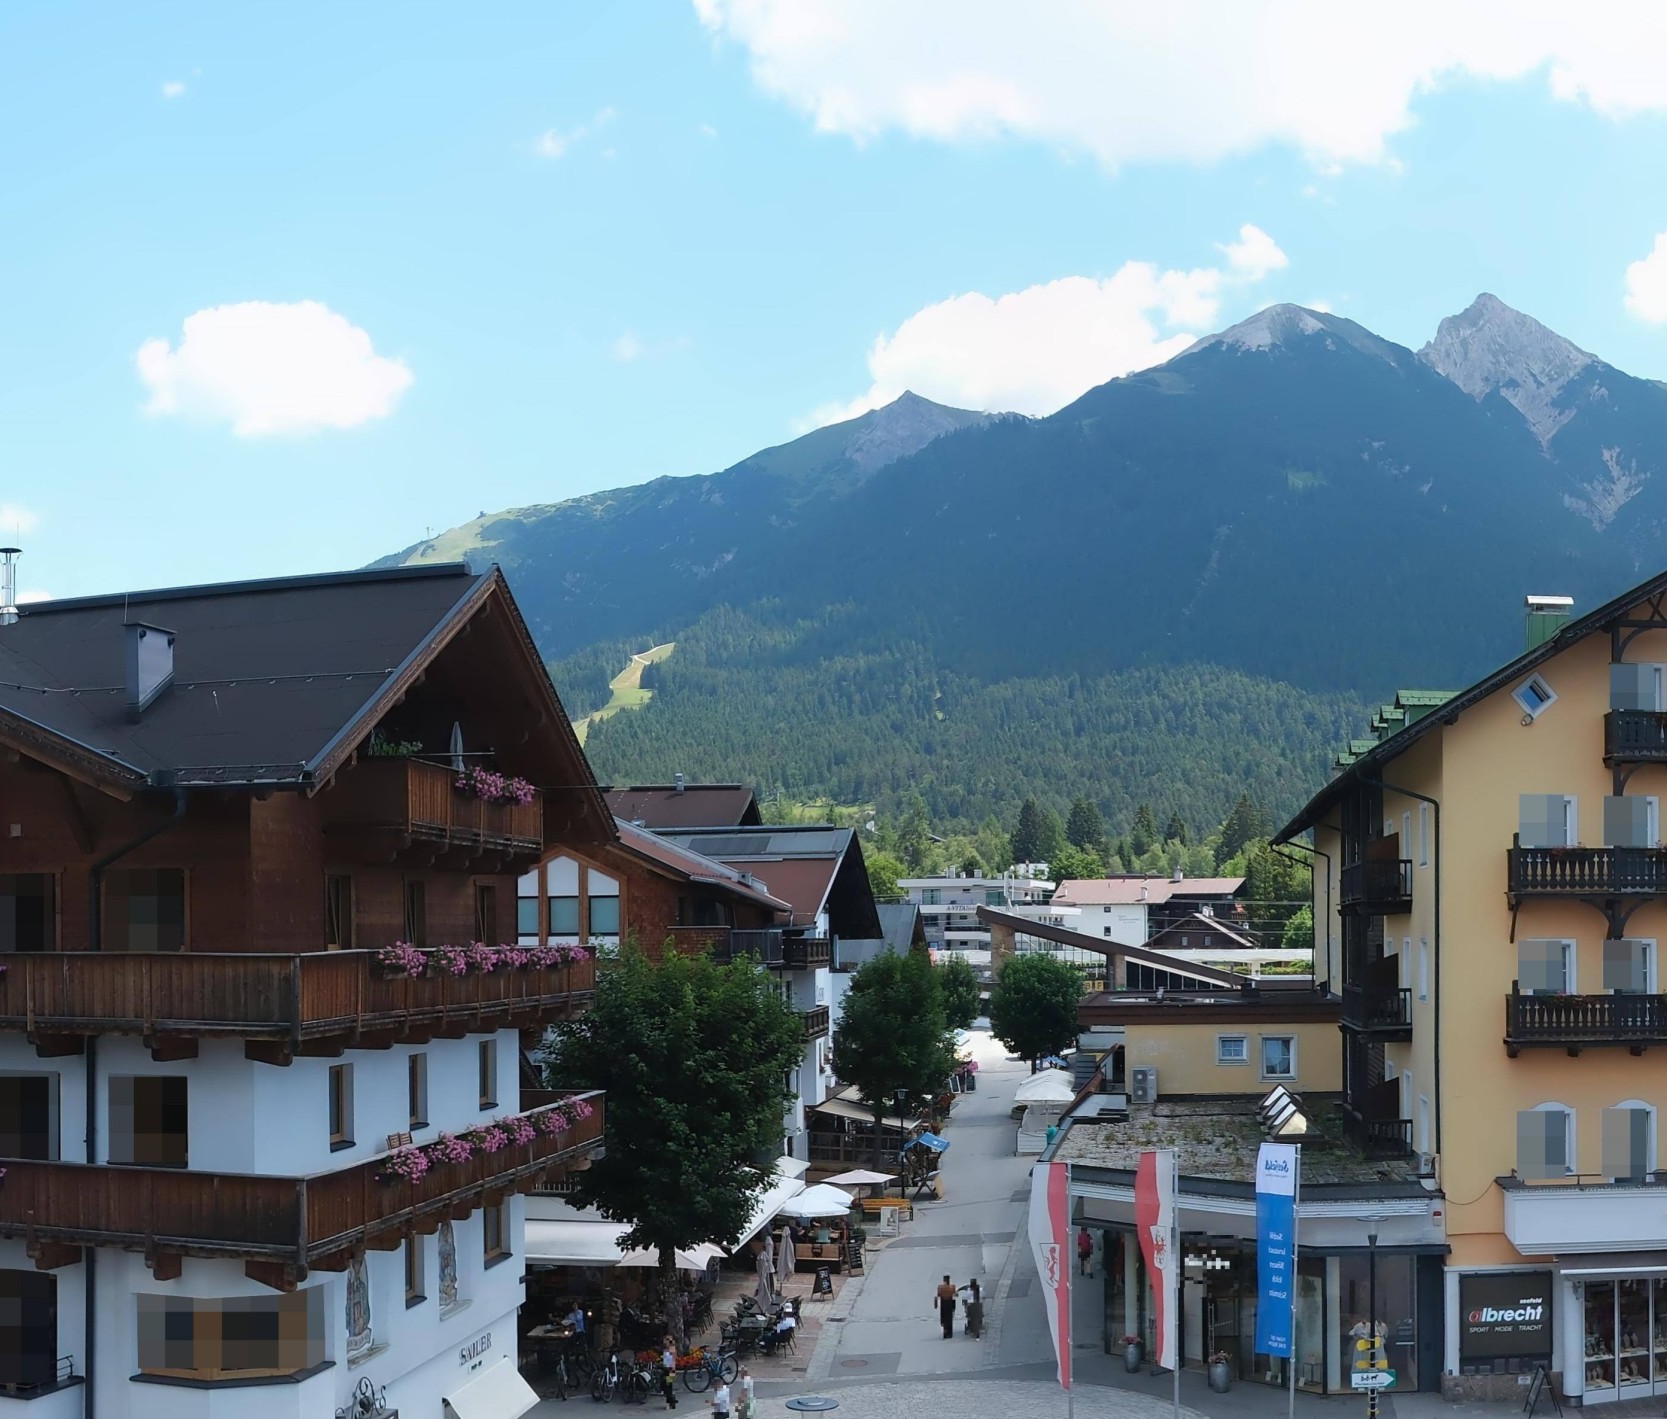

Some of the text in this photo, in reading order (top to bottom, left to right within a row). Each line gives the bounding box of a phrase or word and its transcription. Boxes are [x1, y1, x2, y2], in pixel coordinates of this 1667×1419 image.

[1468, 1305, 1543, 1323] albrecht
[1469, 1326, 1489, 1334] SPORT
[1494, 1325, 1513, 1333] MODE
